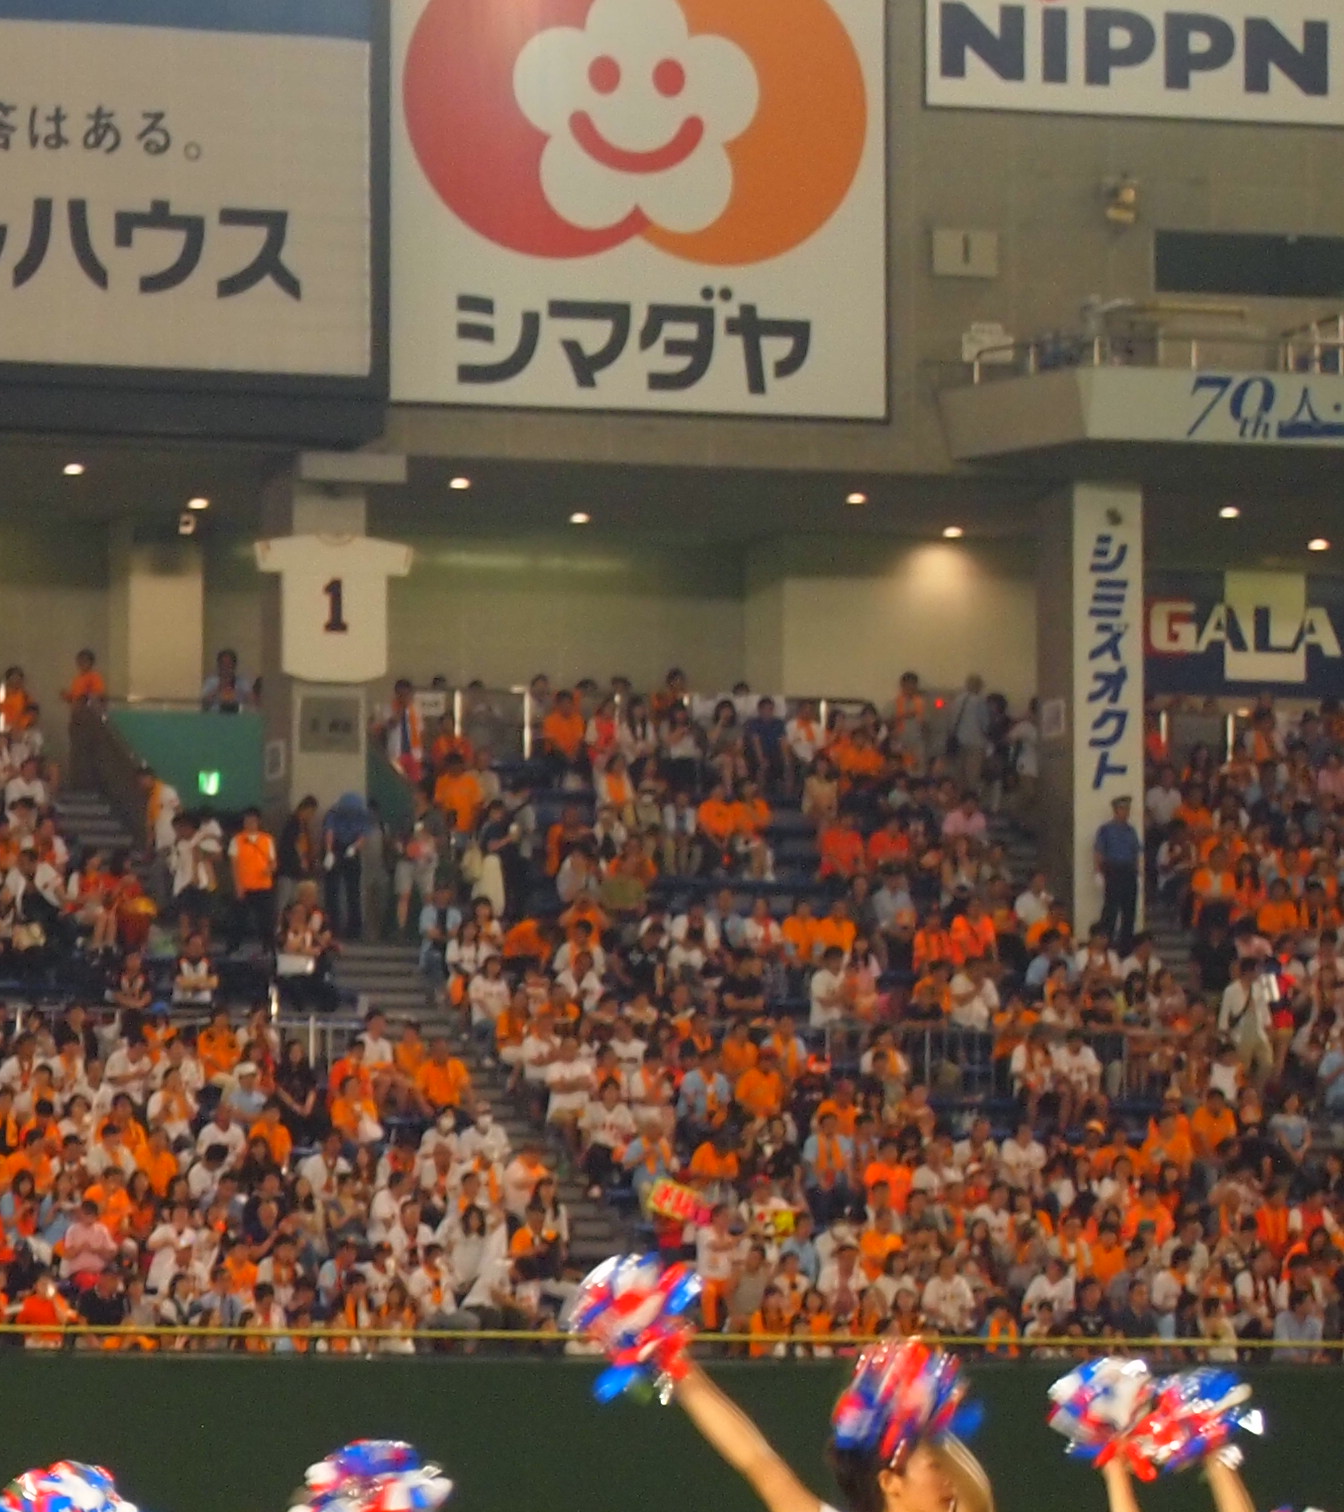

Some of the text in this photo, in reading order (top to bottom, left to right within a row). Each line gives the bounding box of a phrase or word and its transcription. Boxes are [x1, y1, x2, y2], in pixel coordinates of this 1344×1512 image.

[939, 0, 1328, 97] NIPPN
[456, 287, 812, 395] シマダヤ
[323, 579, 347, 632] 1
[1149, 601, 1342, 658] GALA
[1088, 533, 1129, 790] シミズオクト
